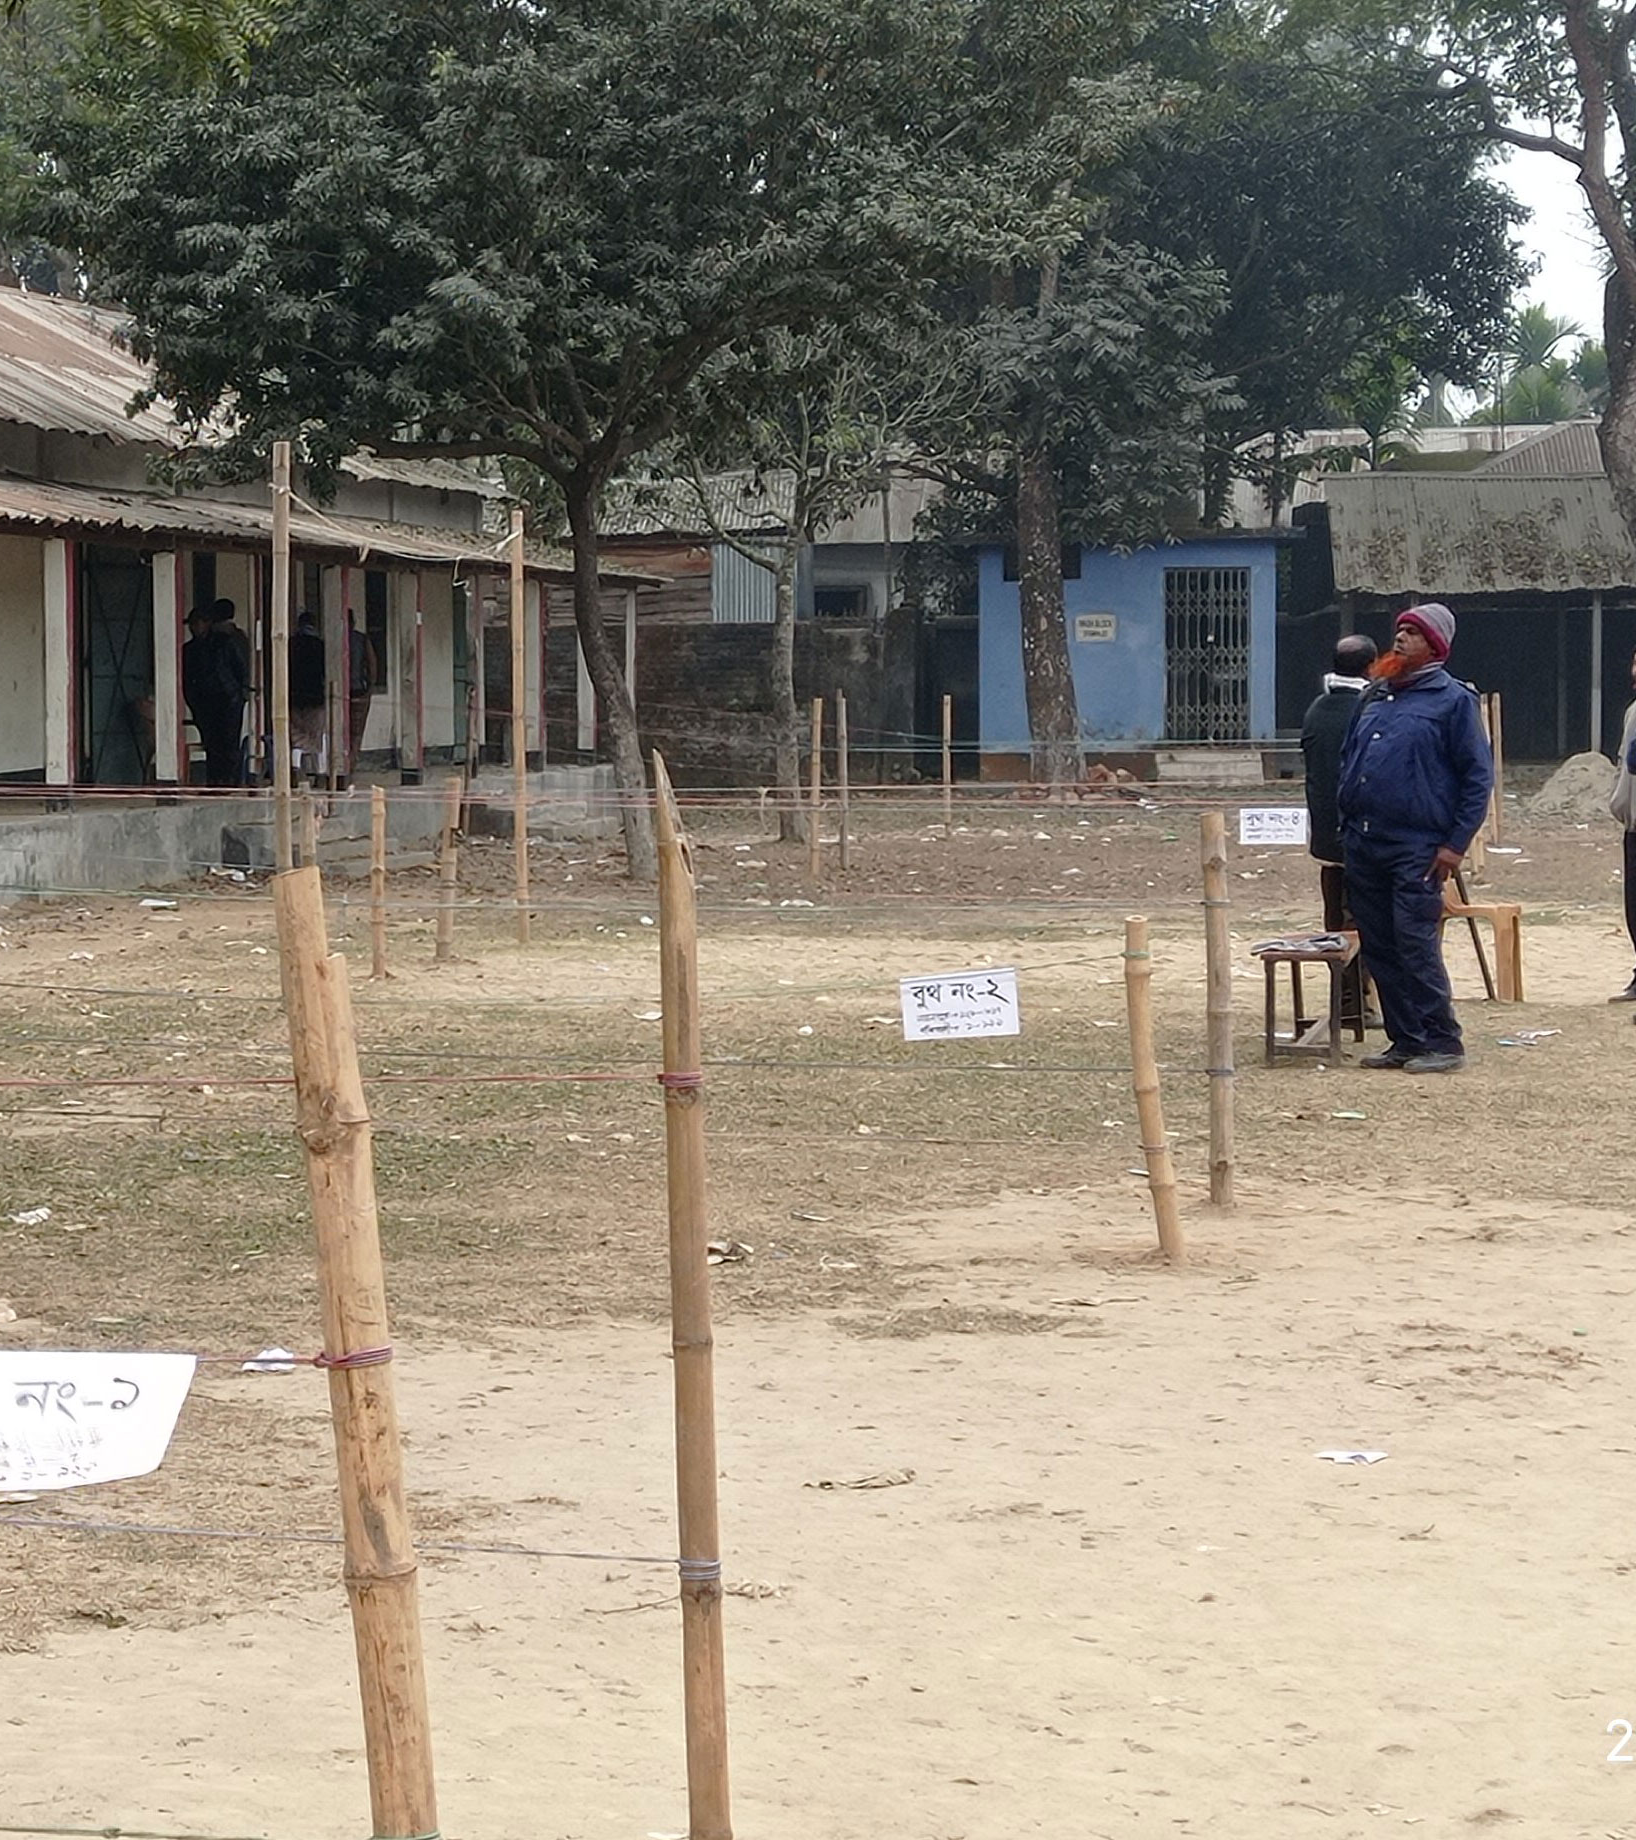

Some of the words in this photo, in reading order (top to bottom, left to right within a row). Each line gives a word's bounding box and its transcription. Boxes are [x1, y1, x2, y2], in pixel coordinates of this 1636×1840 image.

[910, 984, 942, 1009] বুথ
[949, 979, 1010, 1005] নং-২
[14, 1377, 141, 1423] নং-১
